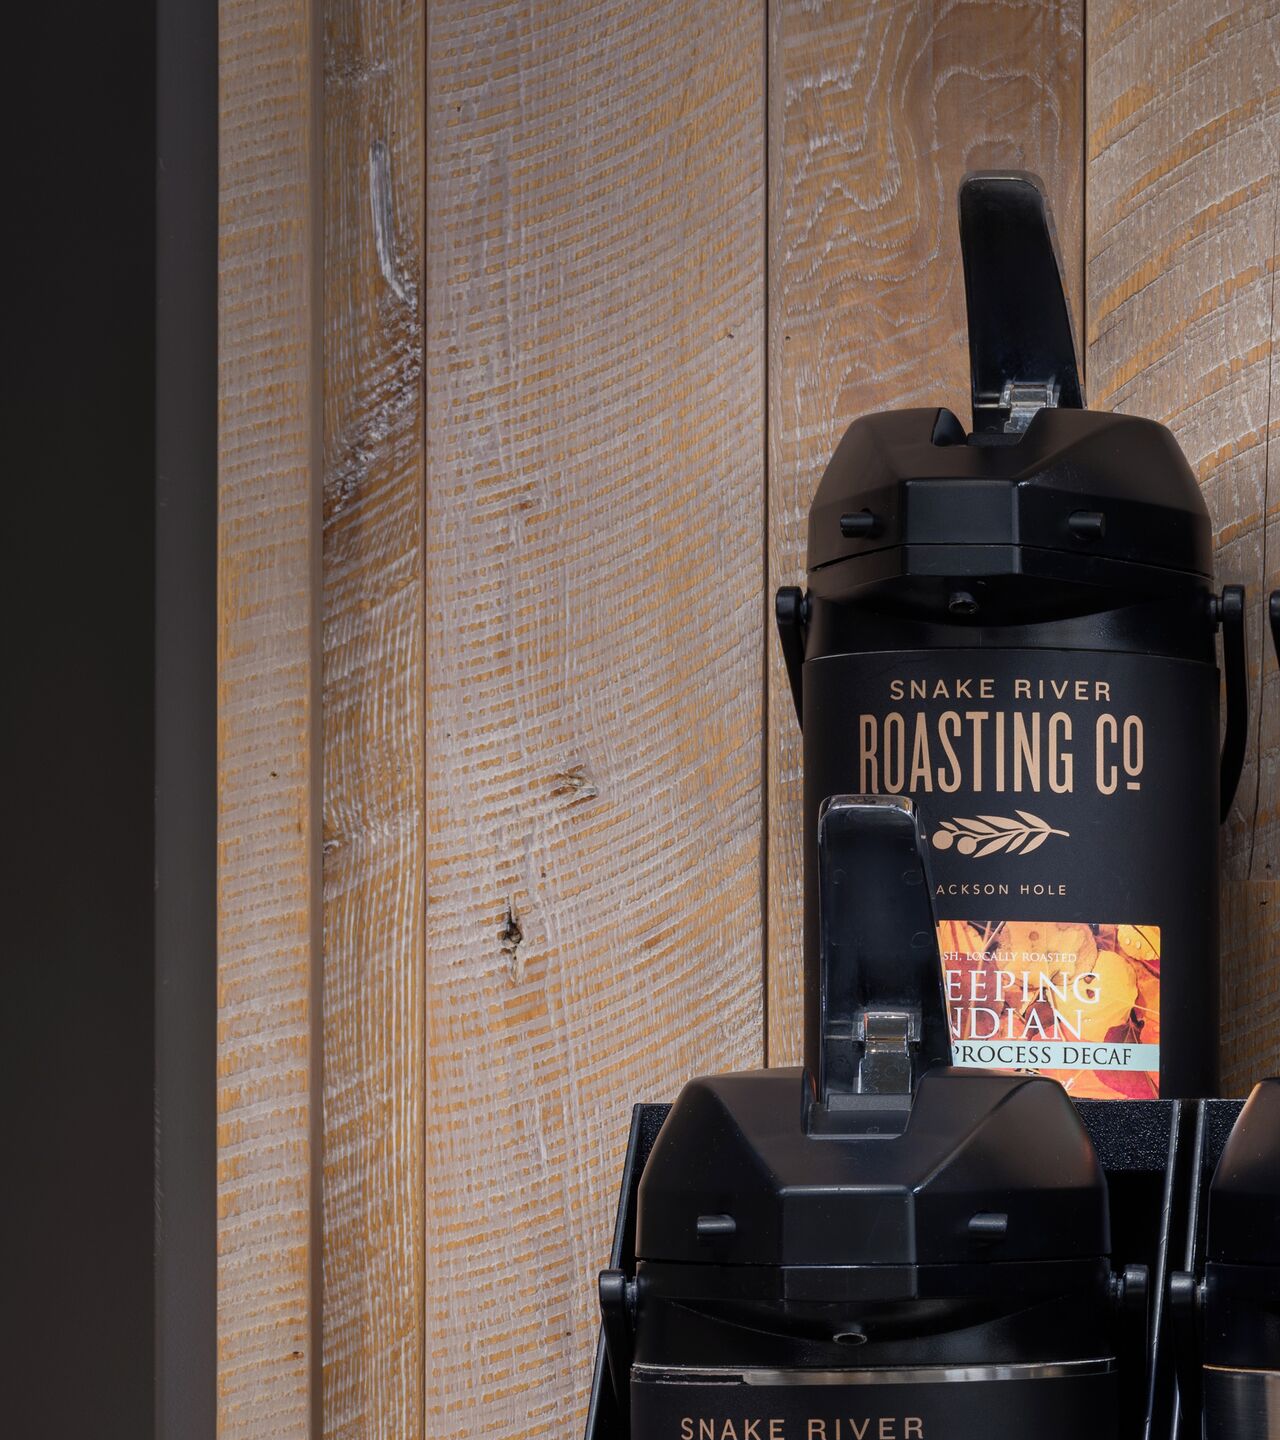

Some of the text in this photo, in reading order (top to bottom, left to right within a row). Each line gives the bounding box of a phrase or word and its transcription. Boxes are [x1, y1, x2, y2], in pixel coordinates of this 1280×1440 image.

[890, 679, 1111, 701] SNAKE RIVER
[859, 711, 1073, 794] ROASTING
[936, 884, 1067, 895] ACKSON HOLE
[967, 952, 1018, 961] LOCALLY
[1022, 953, 1076, 962] ROASTED
[945, 970, 1100, 1004] EEPING
[1063, 1048, 1132, 1065] DECAF
[681, 1417, 924, 1440] SNAKE RIVER
